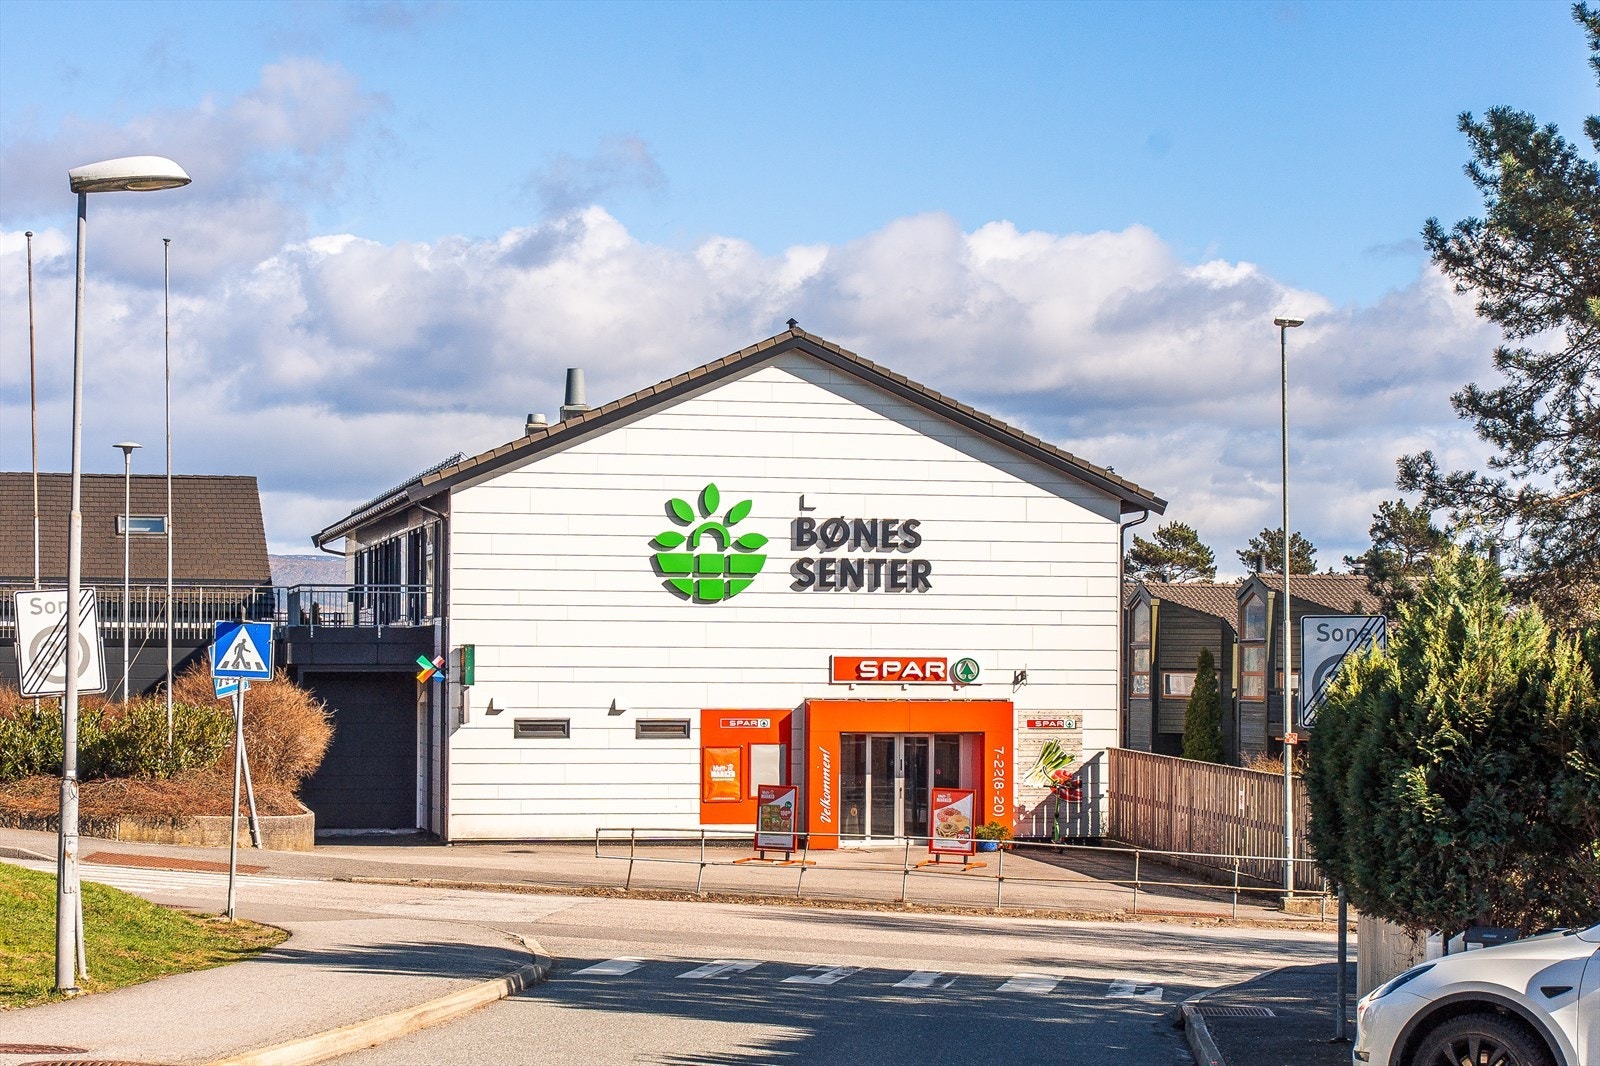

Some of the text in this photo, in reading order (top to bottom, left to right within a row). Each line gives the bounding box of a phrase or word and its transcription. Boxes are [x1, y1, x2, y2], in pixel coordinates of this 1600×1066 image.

[791, 516, 922, 553] BØNES
[790, 557, 932, 593] SENTER
[30, 597, 80, 615] Son
[857, 660, 946, 679] SPAR
[819, 746, 832, 823] Velkommen!
[992, 746, 1005, 817] 7-22(8-20)
